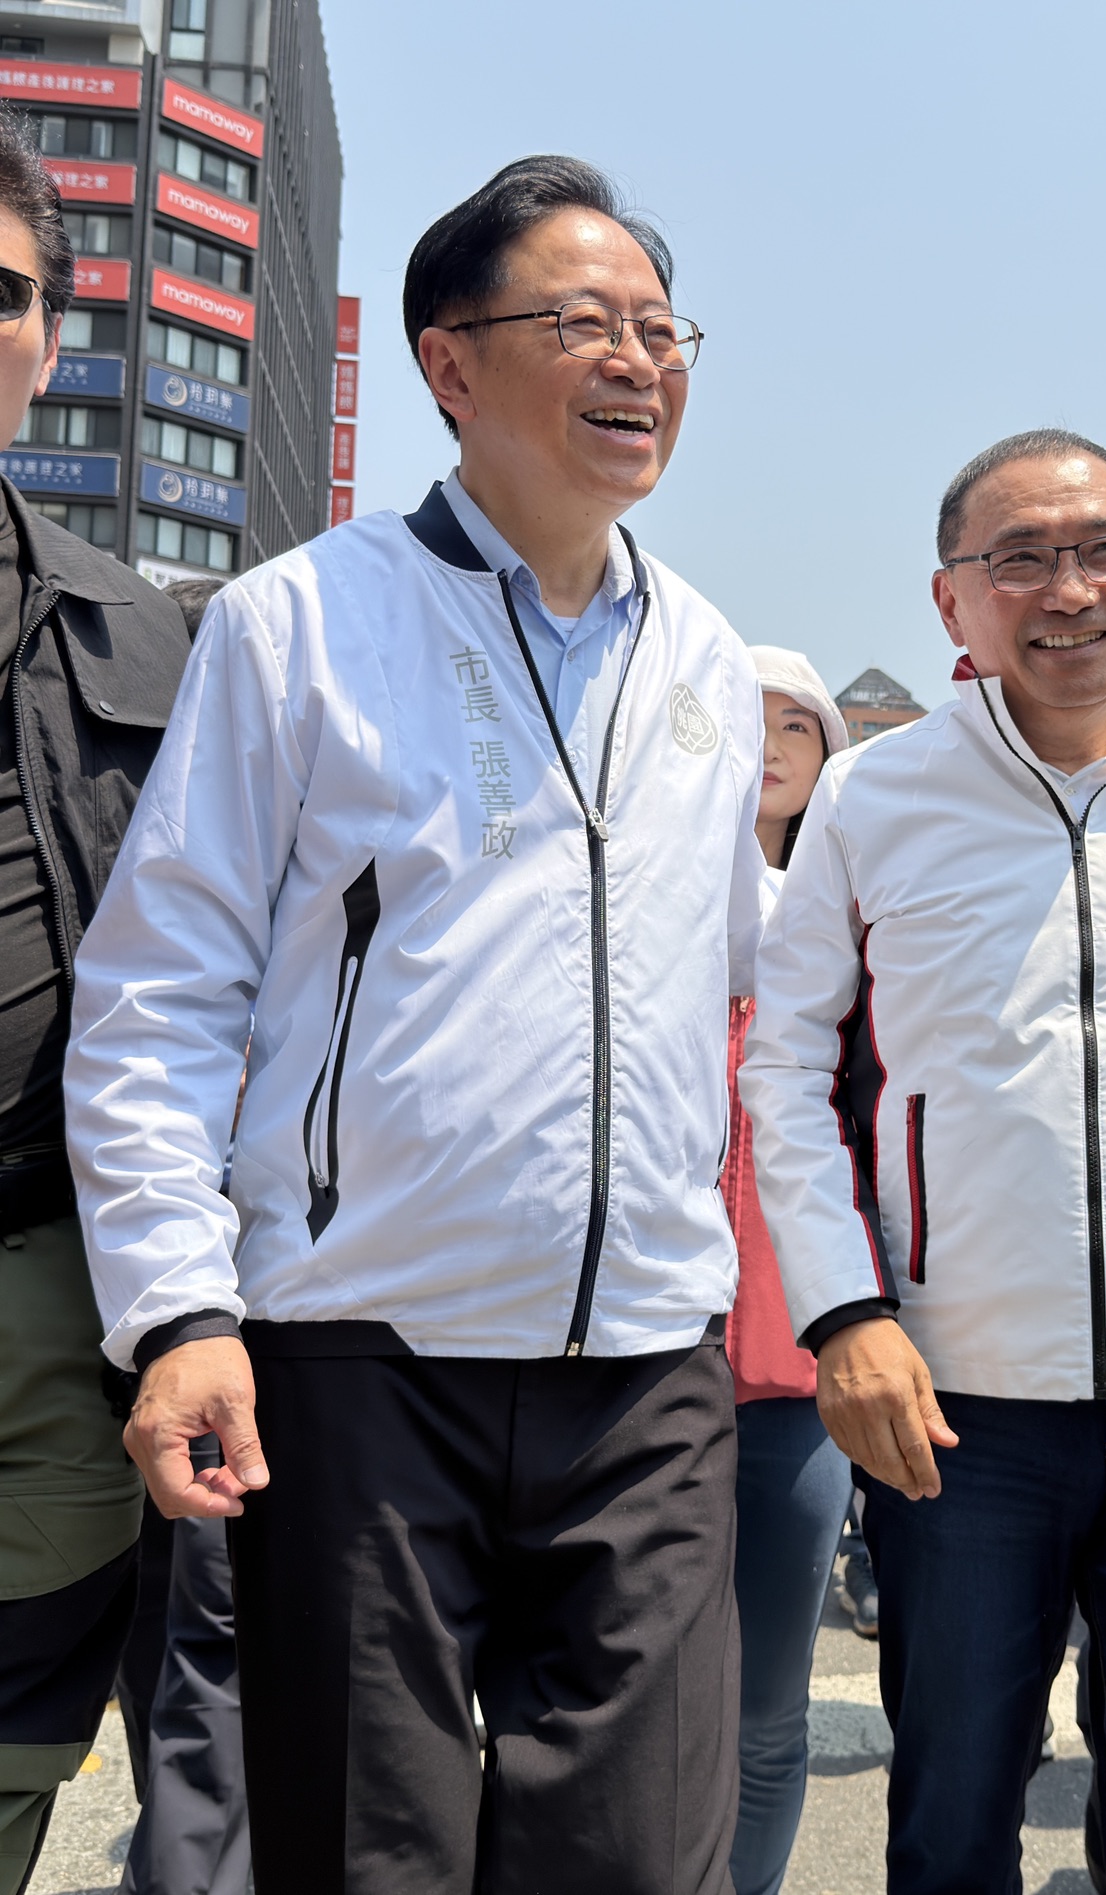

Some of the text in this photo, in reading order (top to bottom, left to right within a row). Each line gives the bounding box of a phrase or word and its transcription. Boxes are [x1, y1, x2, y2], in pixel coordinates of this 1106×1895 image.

[172, 94, 254, 143] mamaway
[167, 187, 249, 235] mamaway
[162, 282, 245, 326] mamaway
[449, 646, 517, 860] 市長 張善政
